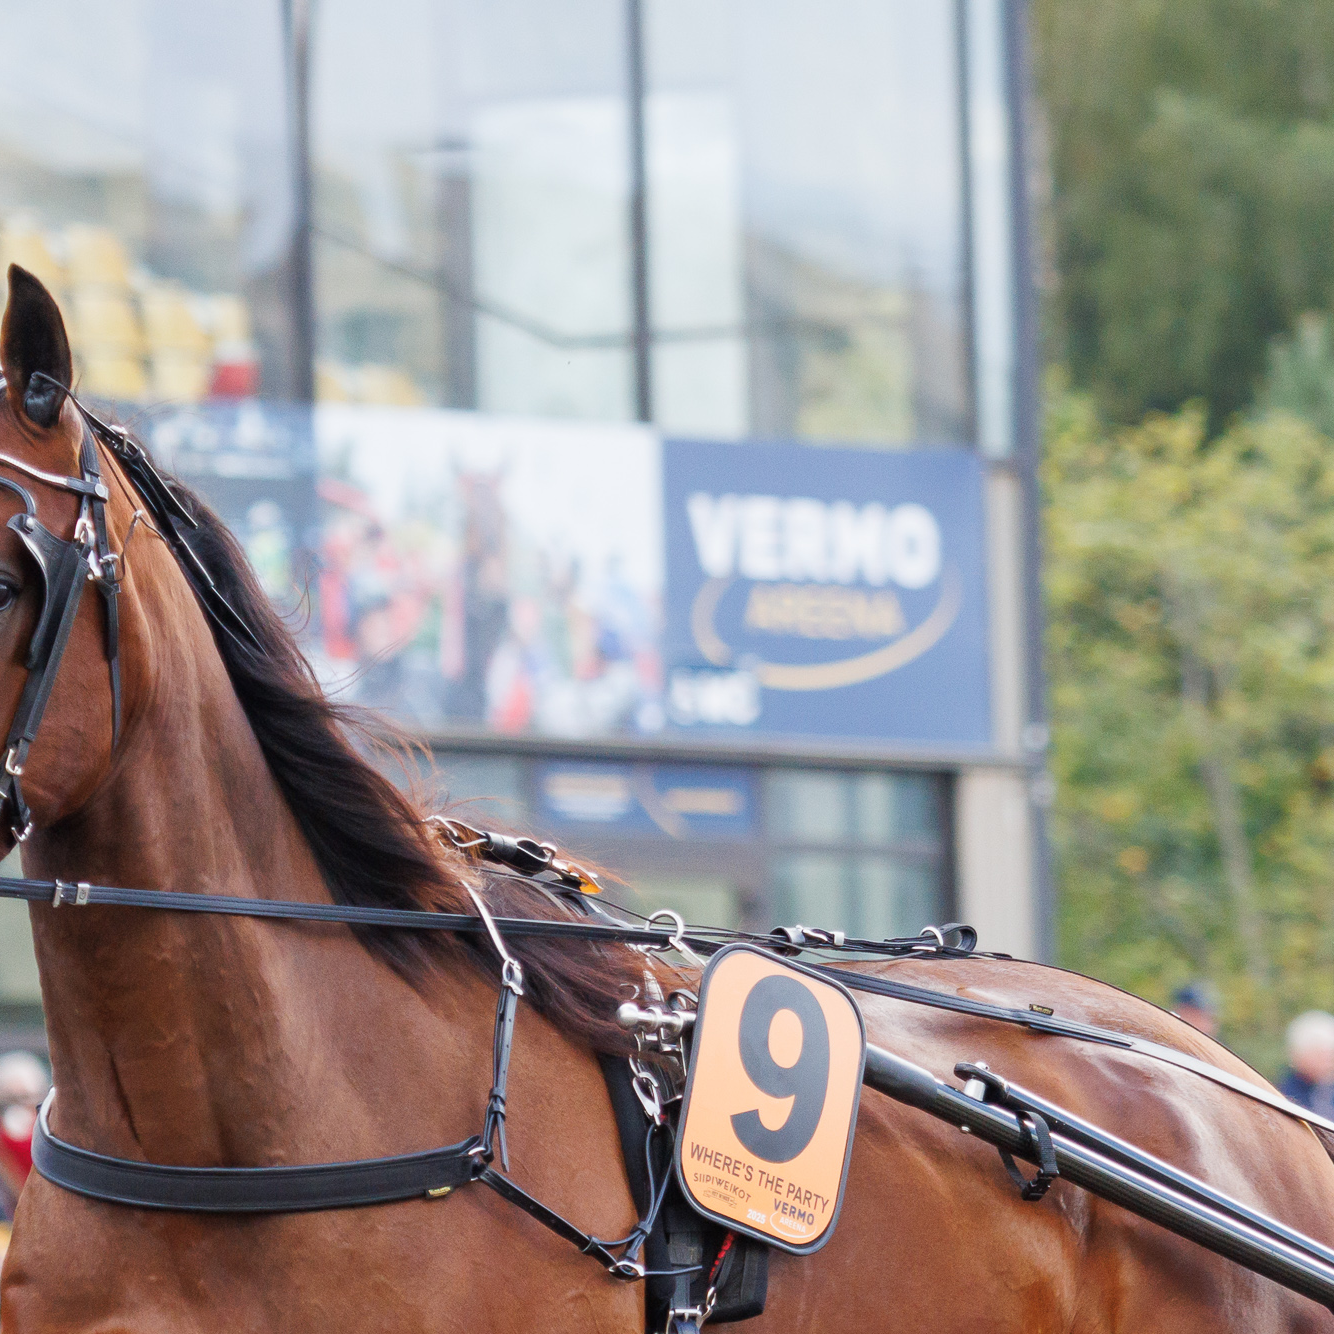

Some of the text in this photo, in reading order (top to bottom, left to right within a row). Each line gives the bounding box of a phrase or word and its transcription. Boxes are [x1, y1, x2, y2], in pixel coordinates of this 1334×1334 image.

[686, 491, 942, 589] VERMO
[729, 974, 830, 1163] 9
[690, 1141, 830, 1214] WHERE'S THE PARTY
[693, 1172, 752, 1203] SIIPIWEIKOT
[746, 1208, 767, 1225] 2025
[773, 1198, 815, 1226] VERMO
[779, 1216, 807, 1234] AREENA
